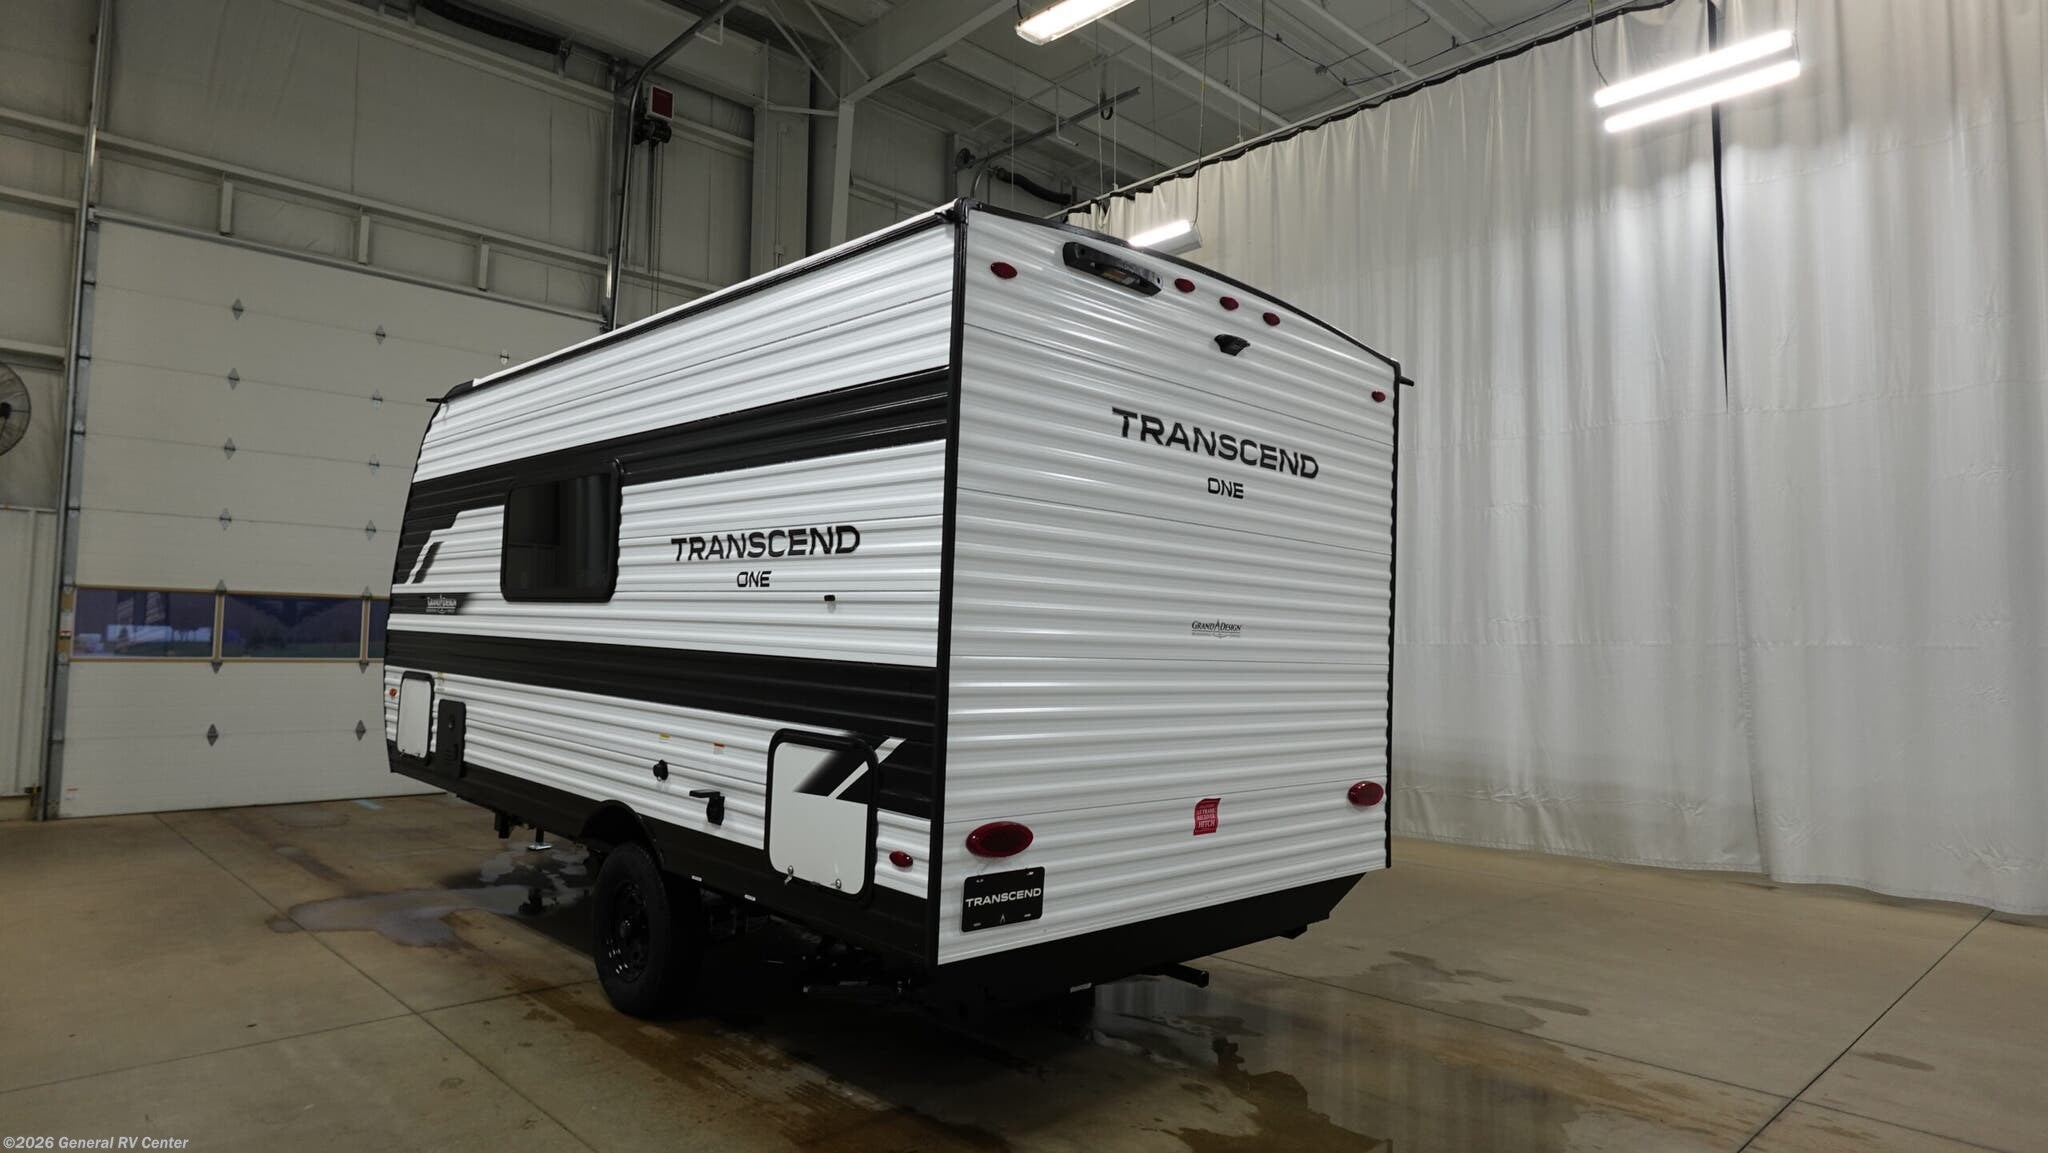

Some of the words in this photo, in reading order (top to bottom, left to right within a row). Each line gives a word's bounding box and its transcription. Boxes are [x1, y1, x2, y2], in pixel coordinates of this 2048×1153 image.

[1112, 406, 1319, 479] TRANSCEND
[1207, 477, 1244, 499] ONE
[671, 525, 860, 561] TRANSCEND
[737, 570, 772, 588] ONE
[965, 888, 1042, 908] TRANSCEND
